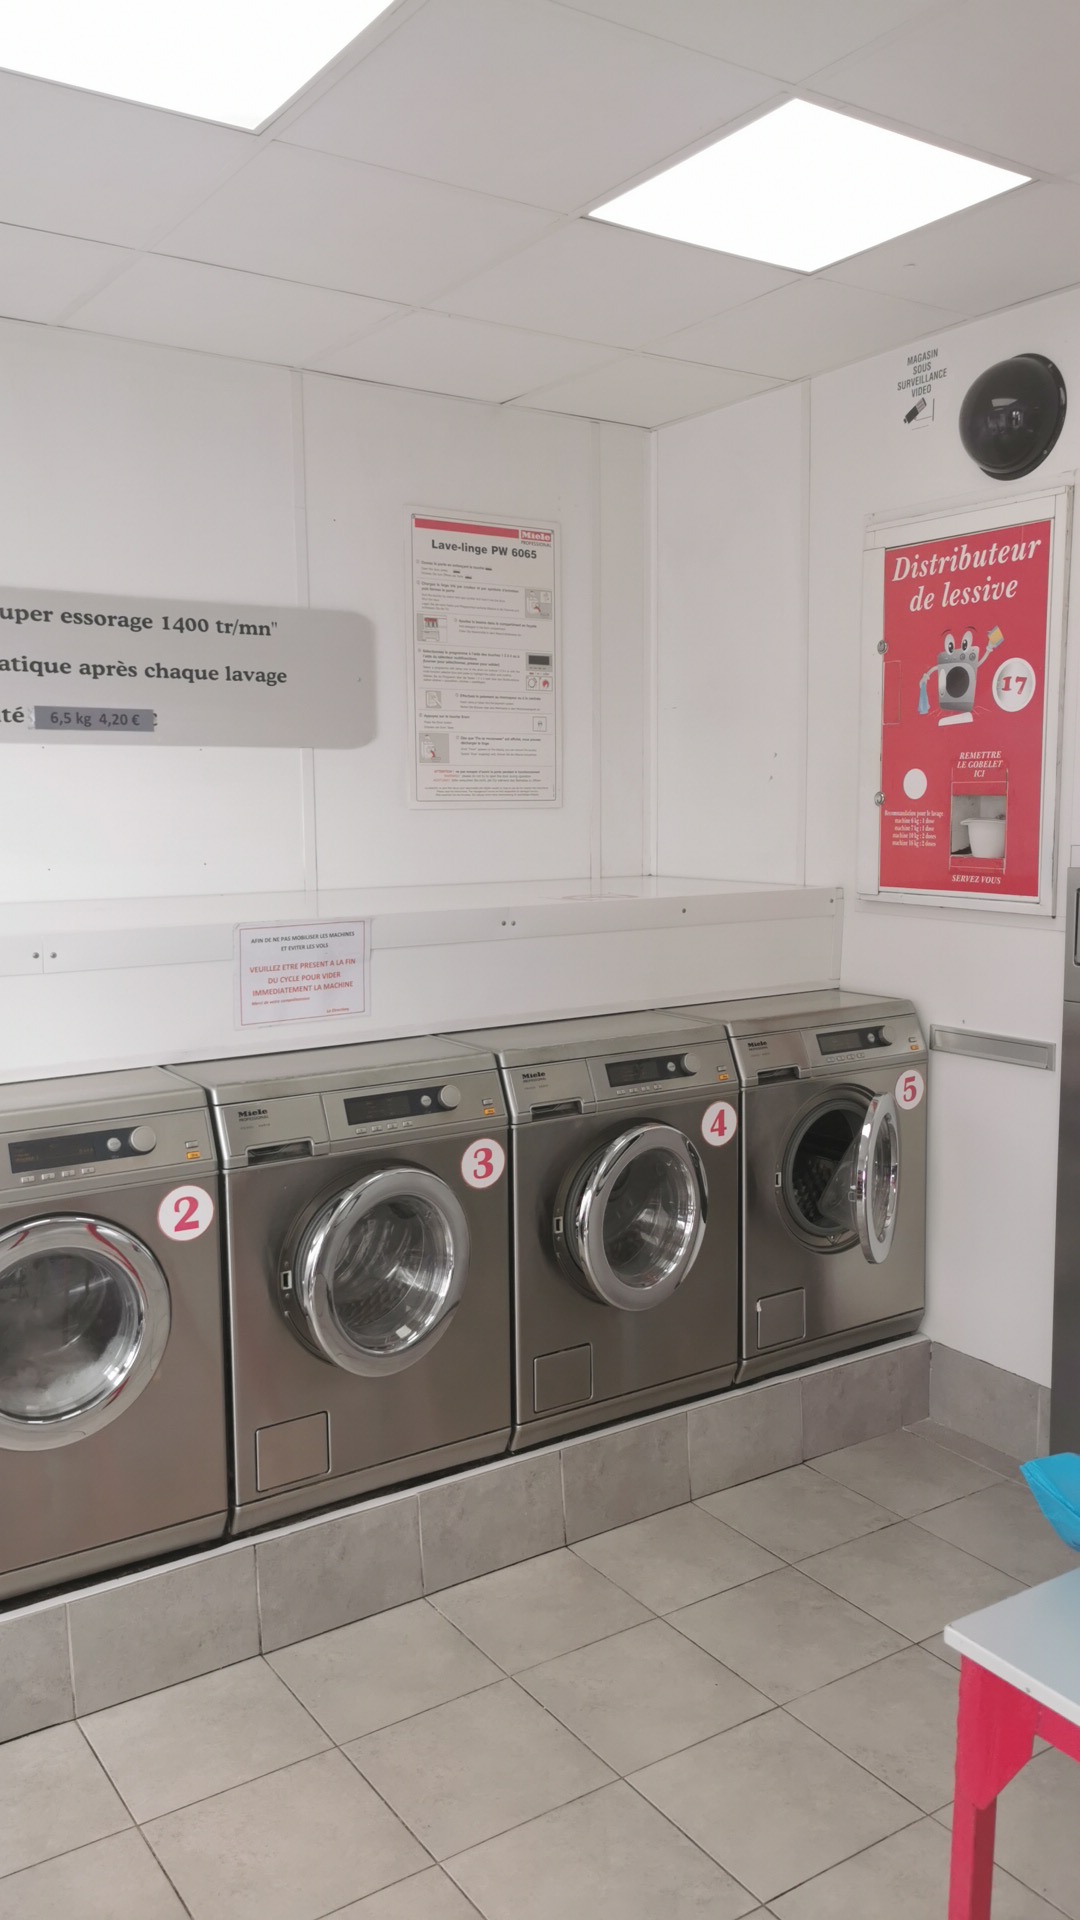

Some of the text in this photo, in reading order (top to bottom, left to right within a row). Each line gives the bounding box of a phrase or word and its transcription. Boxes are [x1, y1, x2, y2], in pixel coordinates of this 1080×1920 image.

[907, 348, 939, 366] MAGASIN
[912, 361, 932, 376] SOUS
[897, 368, 948, 391] SURVEILLANCE
[911, 384, 932, 398] VIDEO
[520, 531, 552, 542] Miele
[431, 539, 538, 559] Lave-linge PW 6065
[891, 537, 1042, 582] Distributeur
[909, 576, 1019, 613] de lessive
[60, 610, 154, 632] essorage
[162, 616, 210, 634] 1400
[216, 618, 279, 637] tr/mn"
[78, 660, 138, 680] après
[144, 662, 220, 683] chaque
[225, 666, 288, 686] lavage
[1001, 676, 1028, 695] 17
[0, 706, 24, 723] té
[50, 712, 72, 726] 6,5
[76, 712, 92, 728] kg
[99, 713, 128, 728] 4,20
[132, 714, 140, 726] €
[958, 750, 1002, 760] REMETTRE
[956, 759, 1004, 769] LE GOBELET
[974, 769, 985, 778] ICI
[952, 874, 1002, 886] SERVEZ VOUS
[250, 964, 280, 973] VEUILLEZ
[300, 960, 328, 969] PRESENT
[280, 975, 300, 984] CYCLE
[252, 985, 312, 997] IMMEDIATEMENT
[323, 981, 353, 990] MACHINE
[522, 1071, 546, 1079] Miele
[903, 1076, 917, 1102] 5
[238, 1108, 268, 1118] Miele
[710, 1109, 728, 1137] 4
[472, 1147, 493, 1180] 3
[173, 1196, 200, 1232] 2
